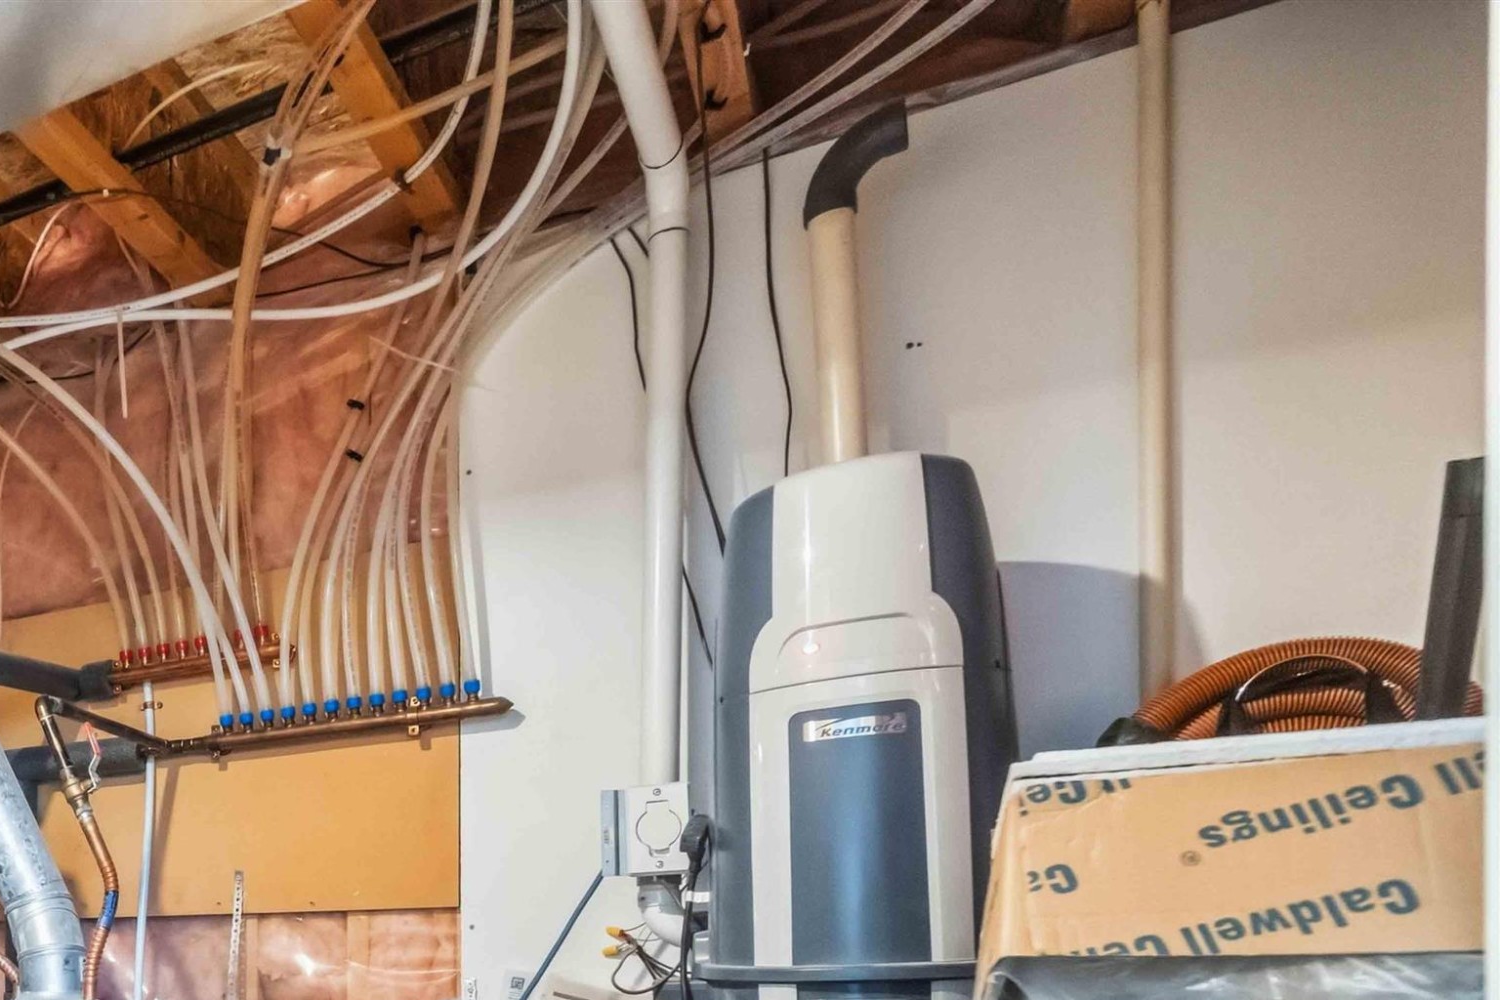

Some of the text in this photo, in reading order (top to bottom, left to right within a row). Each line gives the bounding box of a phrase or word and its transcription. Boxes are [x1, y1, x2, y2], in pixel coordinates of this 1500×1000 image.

[820, 723, 905, 738] Kenmore
[1199, 773, 1424, 848] Ceilings
[1180, 879, 1420, 957] Caldwell
